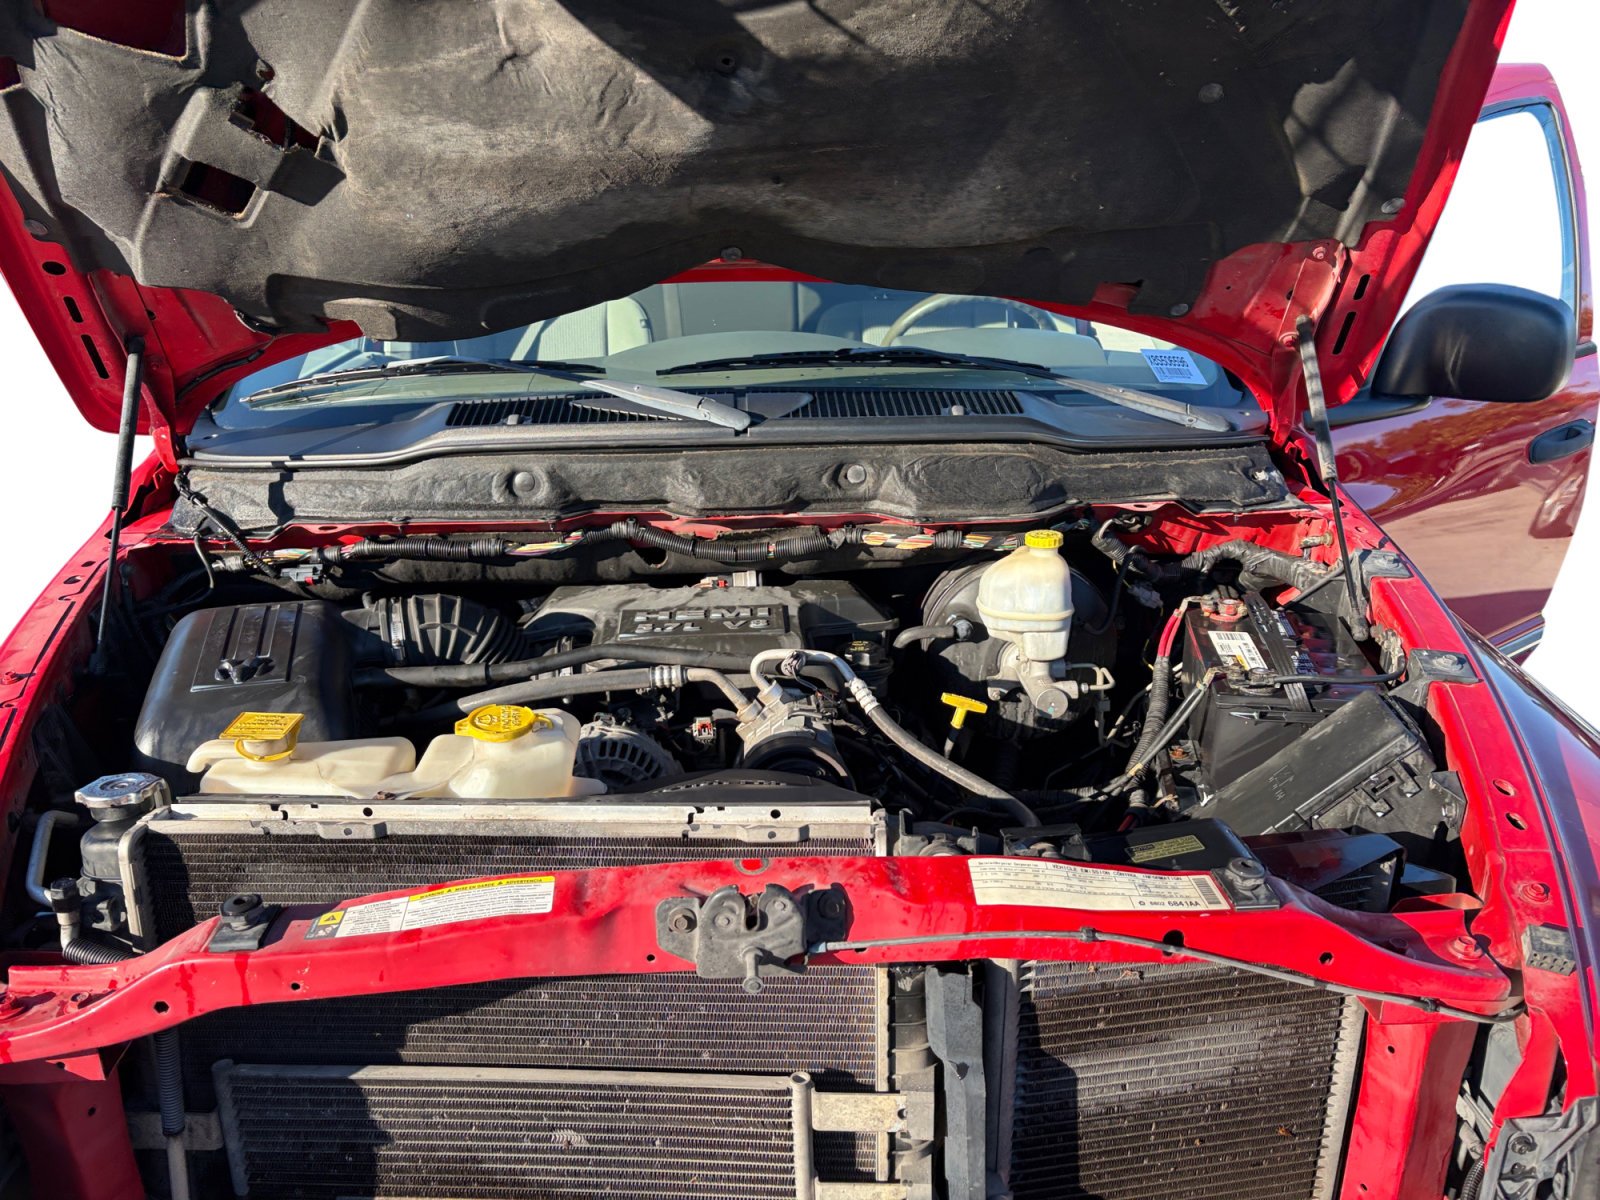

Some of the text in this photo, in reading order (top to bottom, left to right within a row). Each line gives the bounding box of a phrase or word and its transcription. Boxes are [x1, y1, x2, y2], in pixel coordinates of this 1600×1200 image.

[634, 607, 771, 622] HEMI
[635, 619, 769, 633] 5.7L V8
